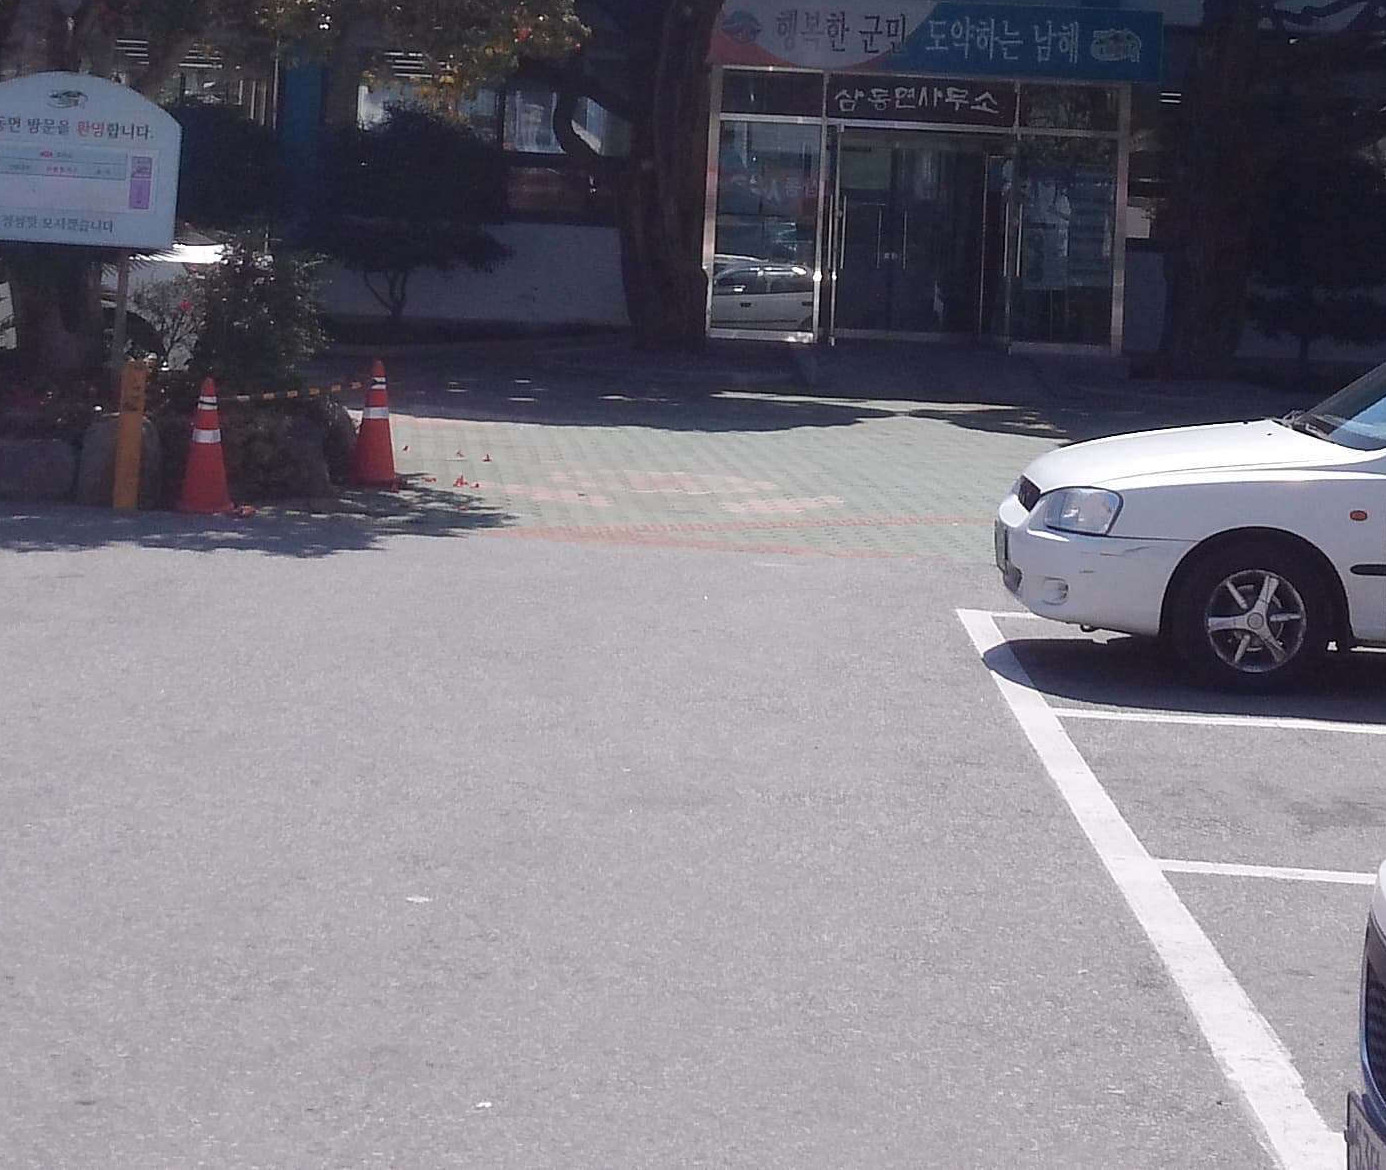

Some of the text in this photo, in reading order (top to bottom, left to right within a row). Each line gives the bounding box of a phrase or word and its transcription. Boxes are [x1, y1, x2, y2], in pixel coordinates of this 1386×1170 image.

[774, 8, 850, 54] 행복한
[858, 13, 908, 56] 군민
[925, 17, 1024, 61] 도약하는
[1034, 19, 1080, 64] 남해
[834, 86, 1000, 114] 삼동면사무소
[27, 117, 71, 136] 방문을
